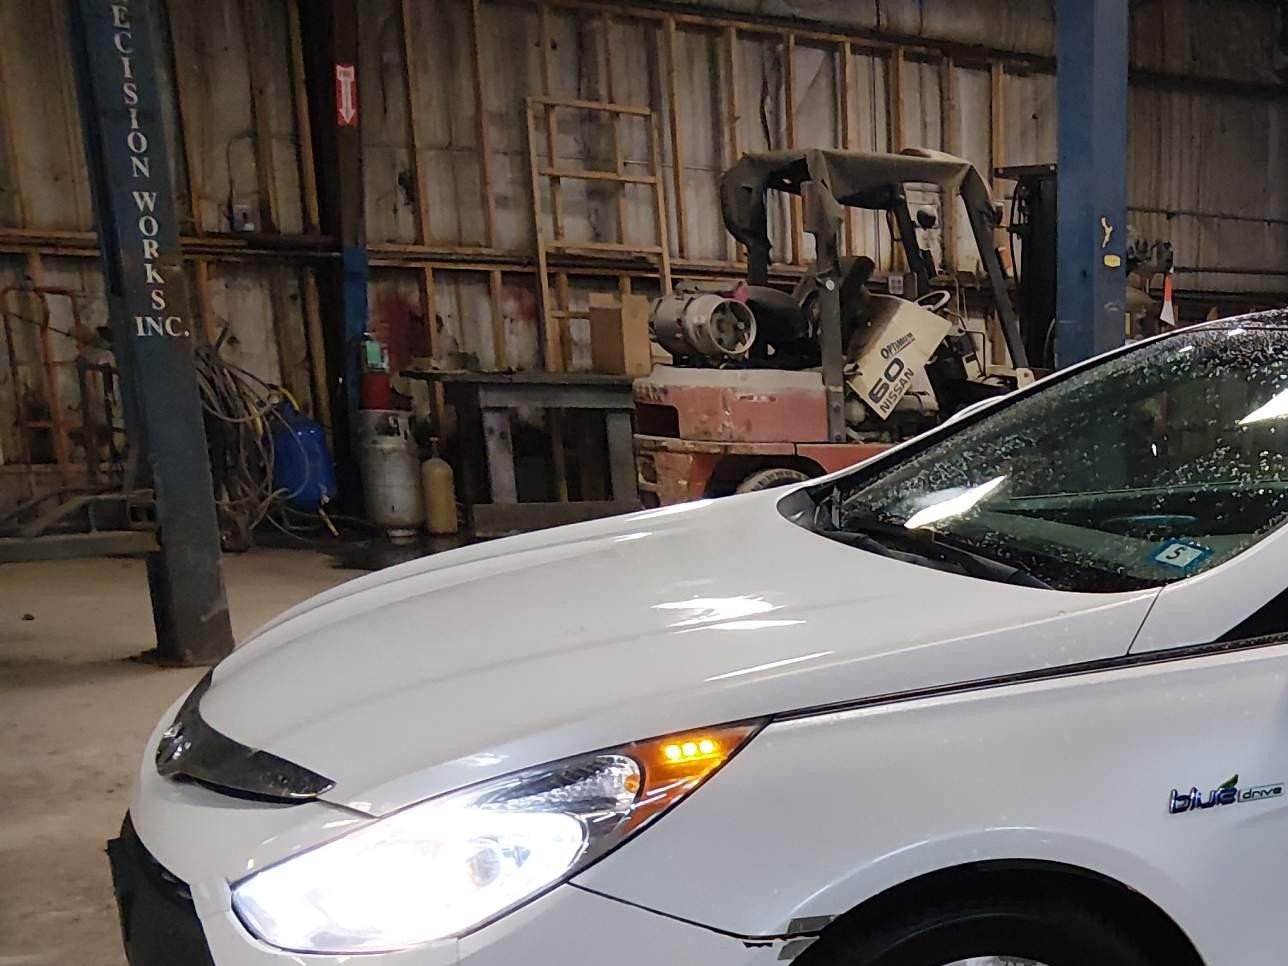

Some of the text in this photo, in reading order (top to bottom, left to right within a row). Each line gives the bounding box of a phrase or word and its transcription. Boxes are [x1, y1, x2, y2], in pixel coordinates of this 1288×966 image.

[112, 0, 166, 311] ECISION WORKS
[136, 315, 191, 338] INC.
[867, 357, 905, 404] 60
[879, 367, 915, 414] NISSAN
[1166, 546, 1187, 560] 5
[1169, 786, 1282, 814] blue drive
